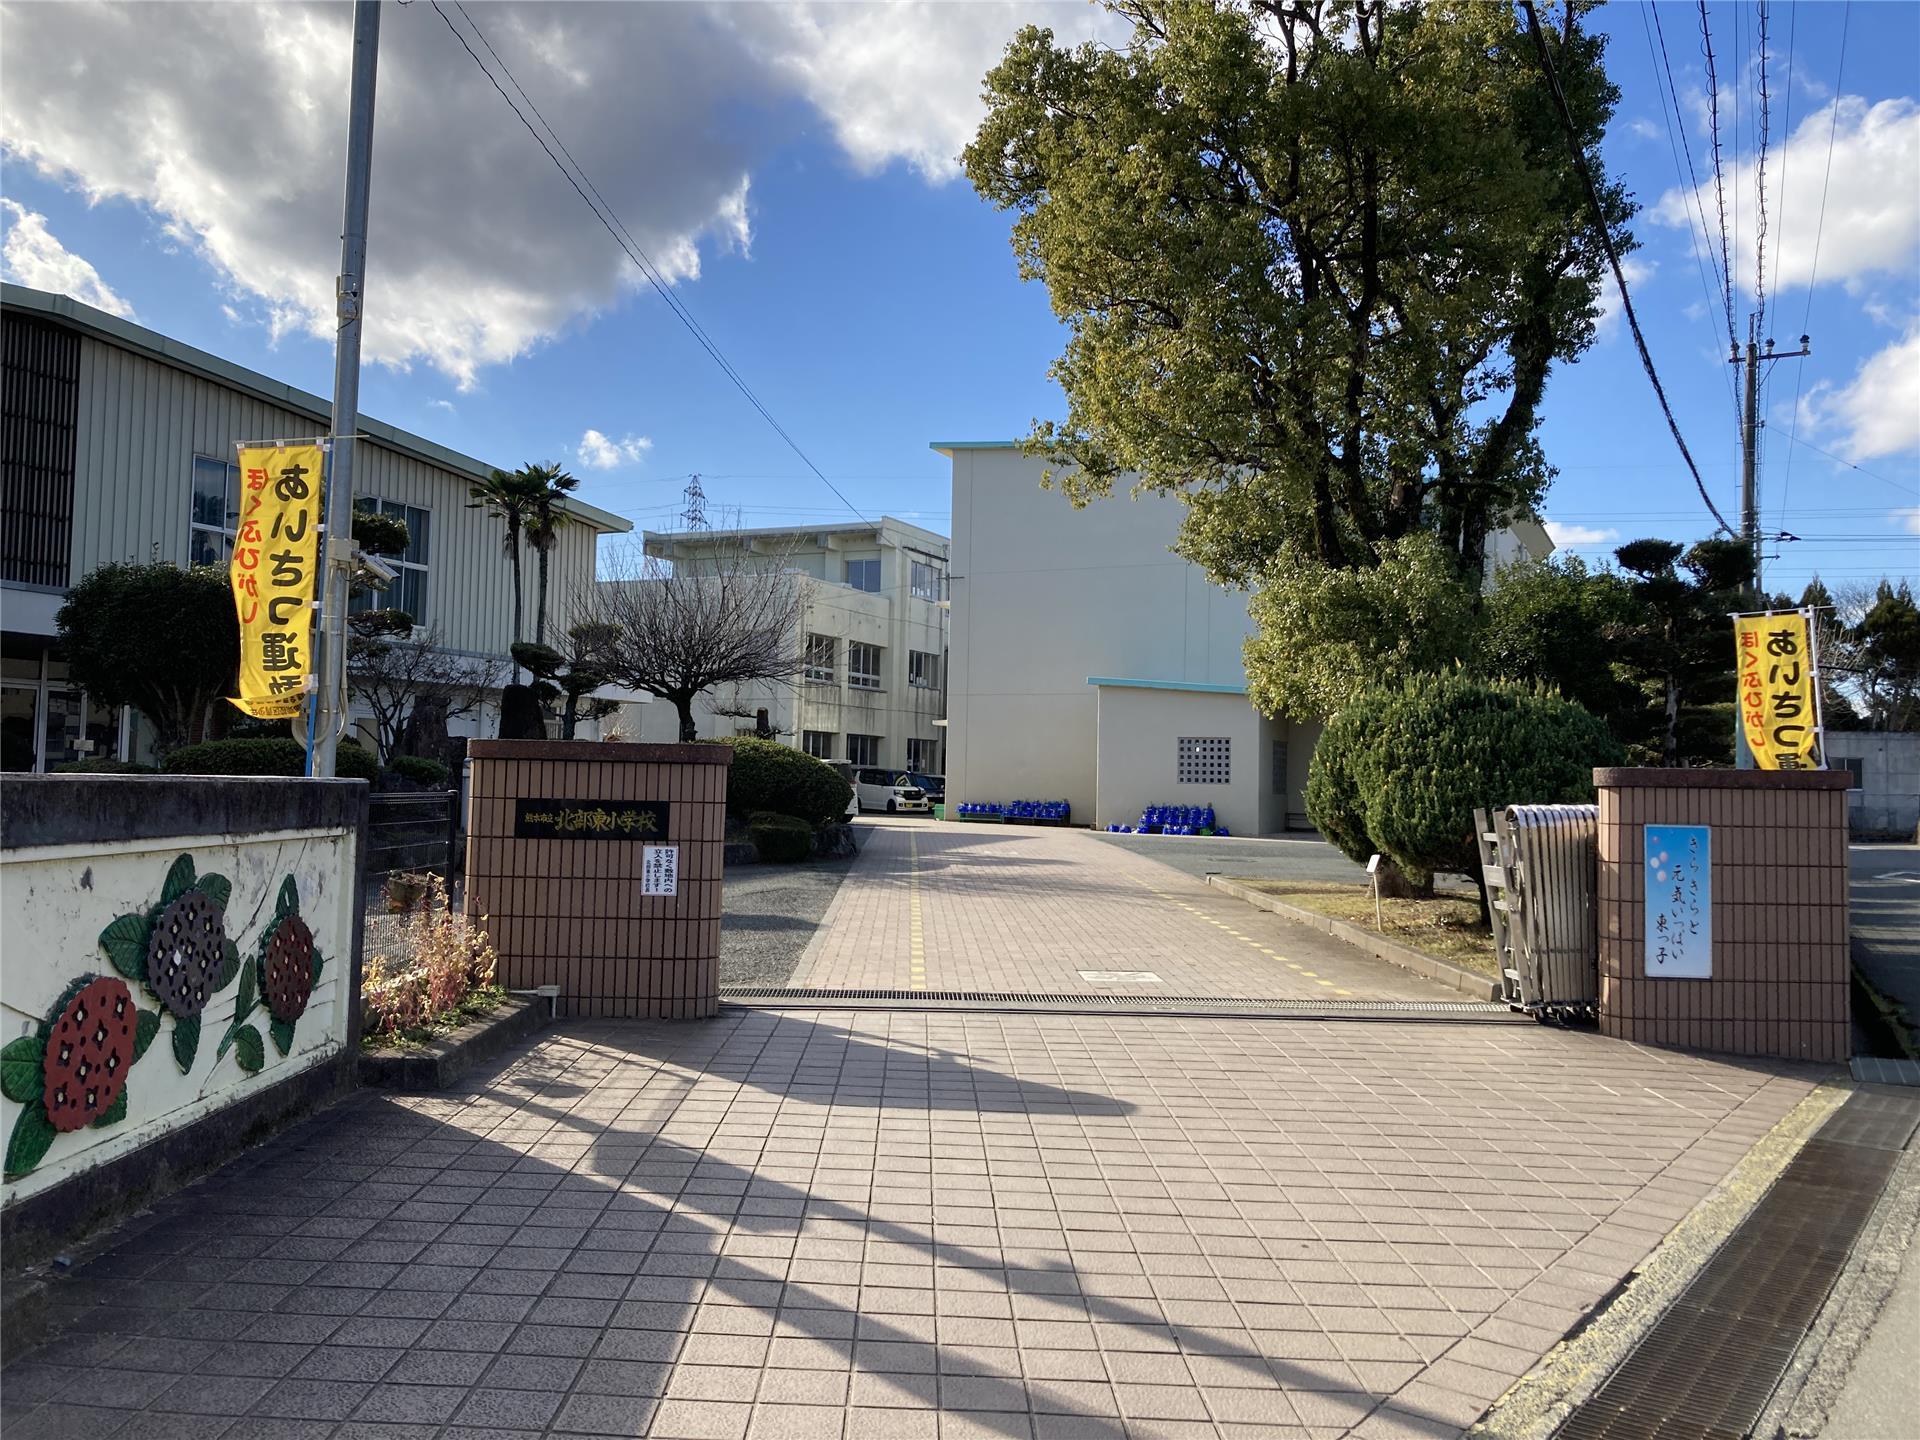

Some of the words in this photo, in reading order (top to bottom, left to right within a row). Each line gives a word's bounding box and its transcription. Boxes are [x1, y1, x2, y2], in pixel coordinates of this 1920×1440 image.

[554, 807, 658, 833] 北部東小学校
[1688, 837, 1701, 935] きらきらと
[1655, 913, 1670, 964] 東っ子
